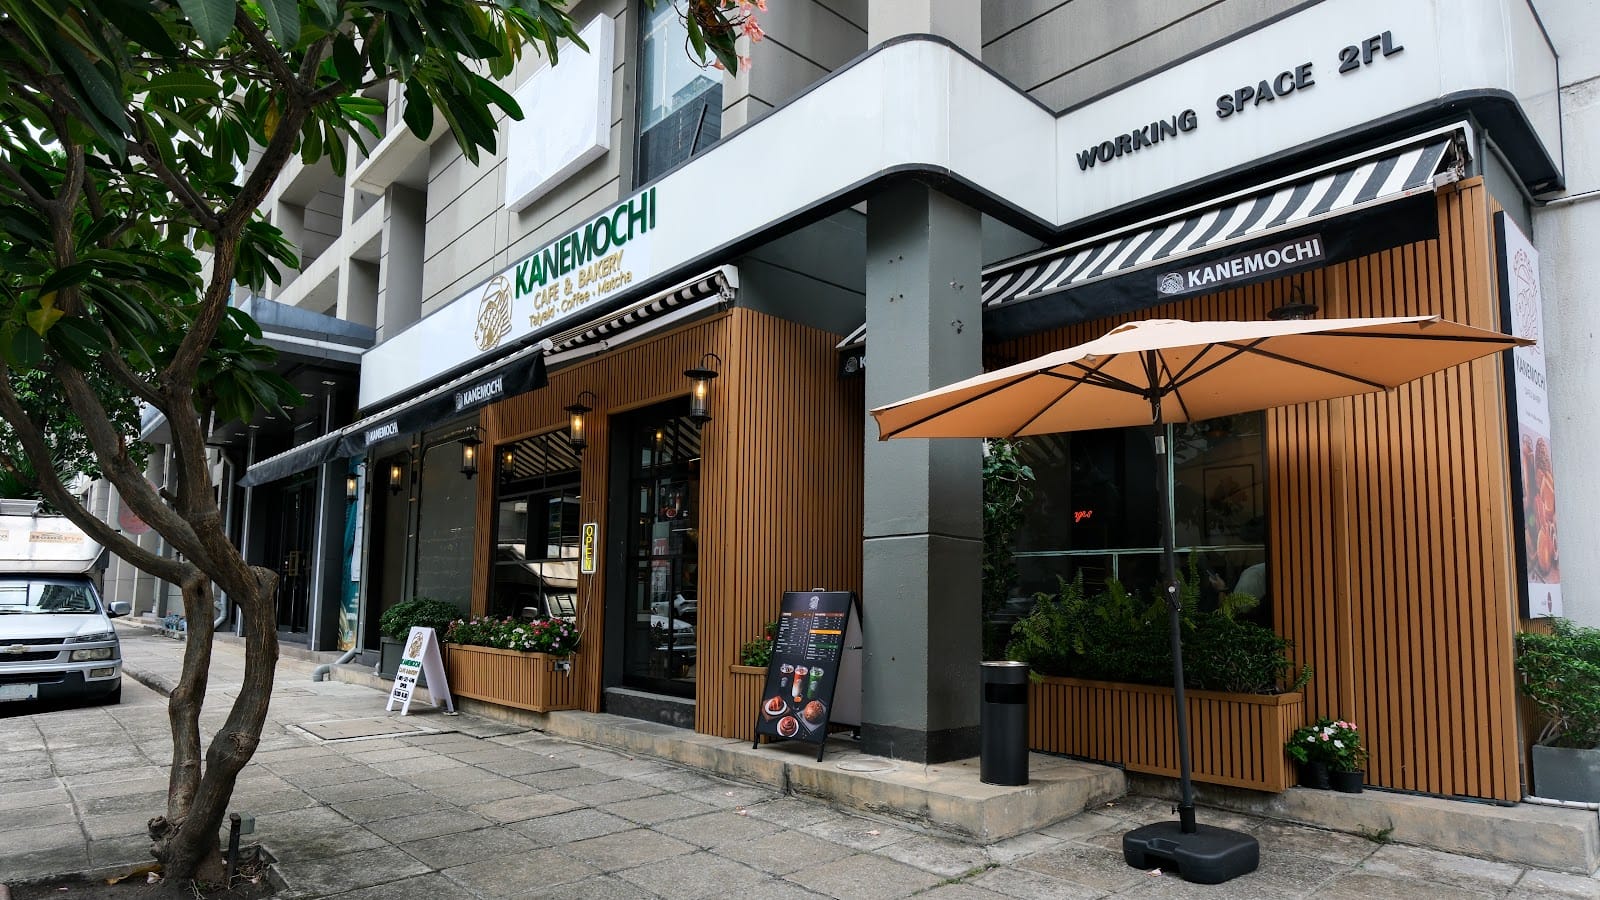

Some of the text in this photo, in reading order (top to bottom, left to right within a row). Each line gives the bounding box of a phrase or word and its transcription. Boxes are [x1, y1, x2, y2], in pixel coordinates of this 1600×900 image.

[1076, 30, 1404, 171] WORKING SPACE 2FL
[515, 187, 656, 299] KANEMOCHI
[1188, 238, 1321, 288] KANEMOCHI
[529, 271, 633, 327] Taiyaki Coffee Matcha
[534, 249, 625, 310] CAFE & BAKERY
[463, 378, 503, 406] KANEMOCHI
[370, 421, 399, 441] KANEMOCHI
[585, 525, 593, 570] OPEN
